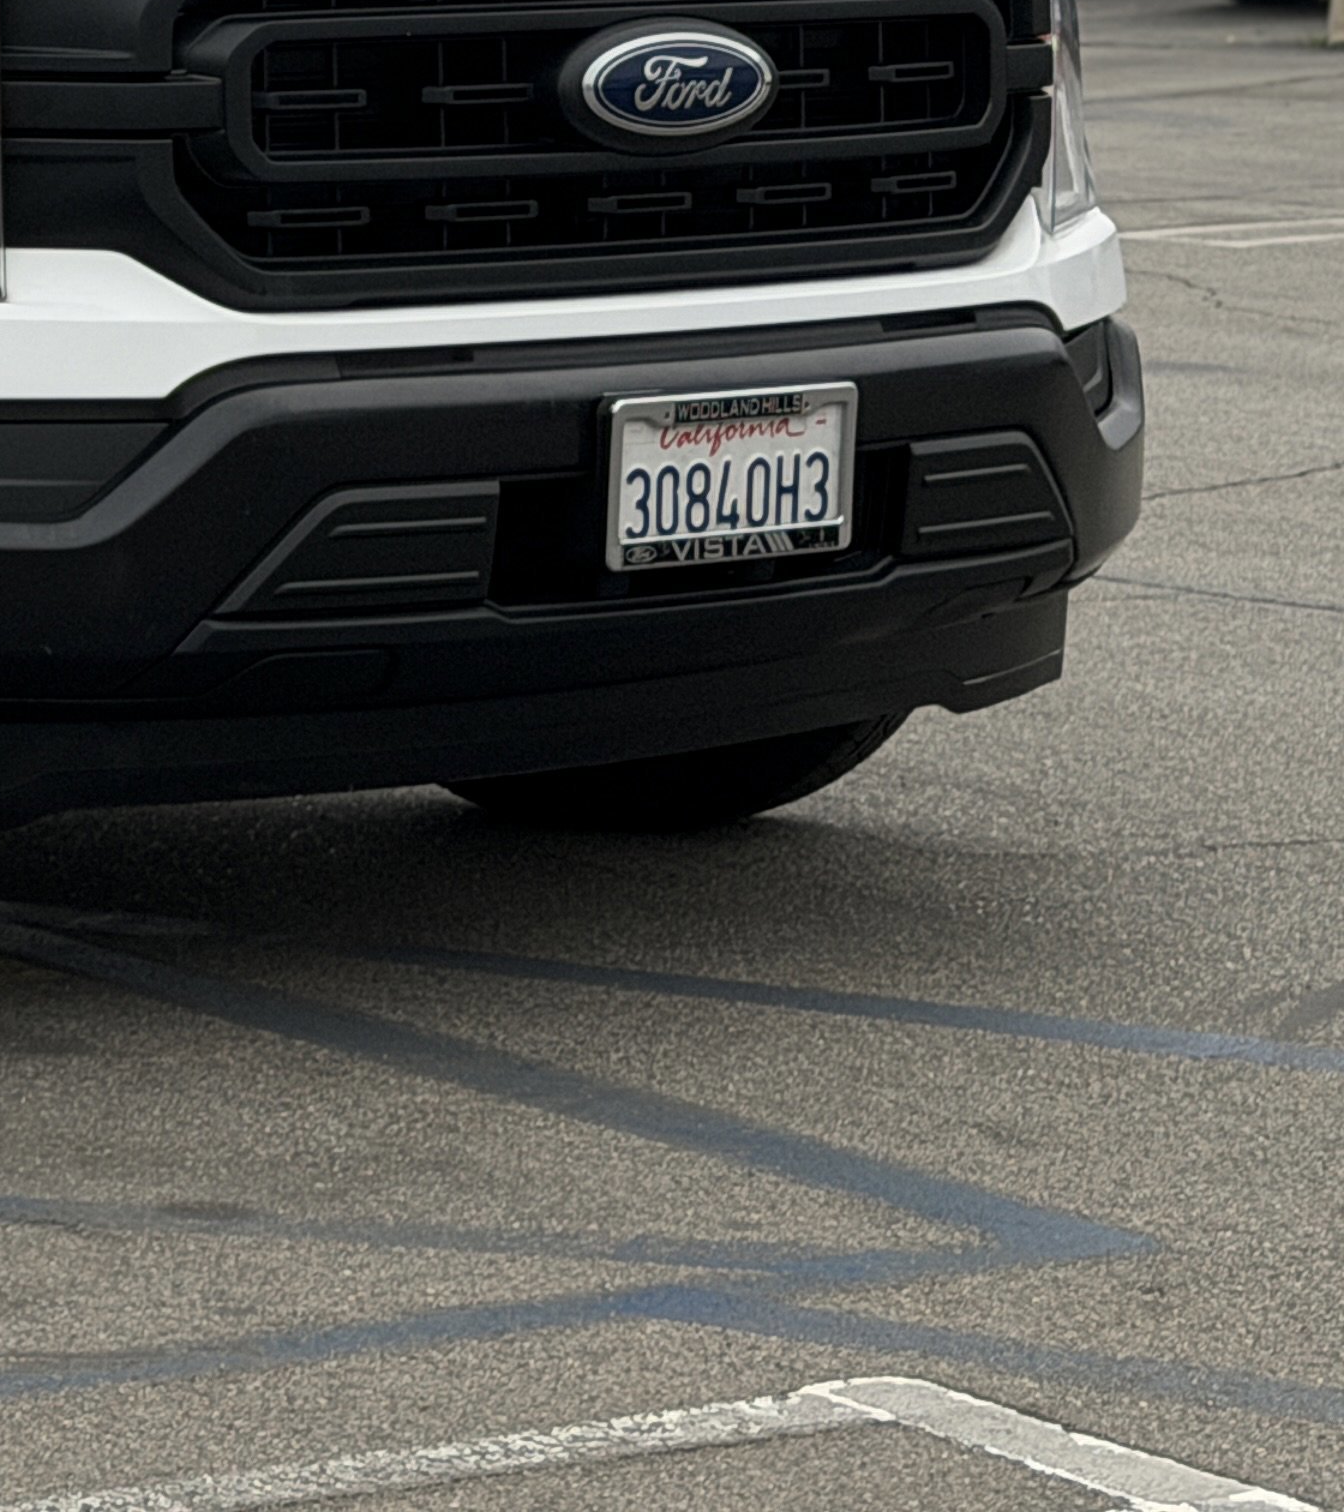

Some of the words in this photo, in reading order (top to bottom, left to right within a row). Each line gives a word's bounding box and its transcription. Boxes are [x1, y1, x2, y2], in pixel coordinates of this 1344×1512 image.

[634, 55, 733, 112] Ford
[676, 398, 760, 421] WOODLAND
[762, 394, 801, 414] HILLS
[660, 417, 805, 457] California
[625, 451, 830, 539] 30840H3
[671, 533, 768, 561] VISTA
